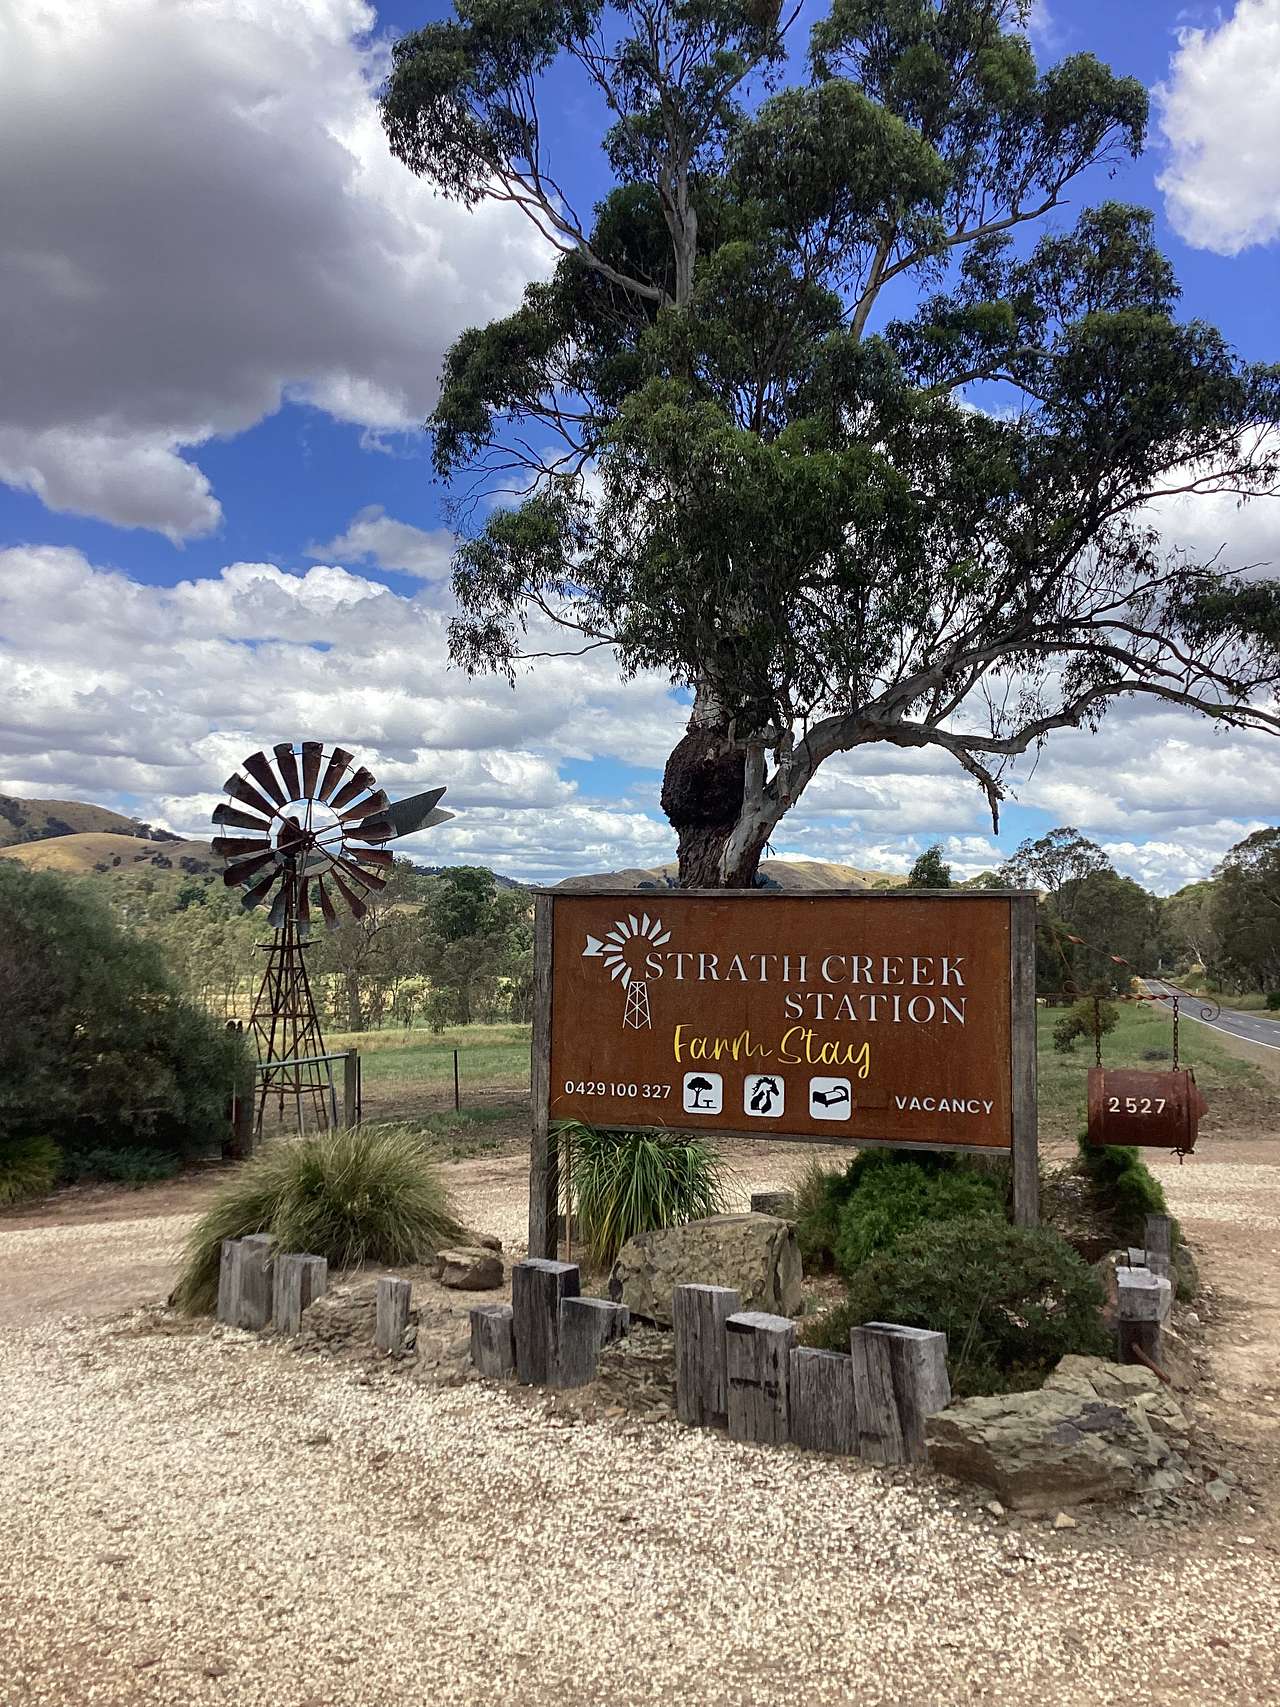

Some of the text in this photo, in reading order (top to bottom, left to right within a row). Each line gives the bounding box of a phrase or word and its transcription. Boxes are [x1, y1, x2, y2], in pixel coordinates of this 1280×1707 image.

[645, 951, 966, 987] STRATH CREEK
[784, 992, 967, 1025] STATION
[673, 1024, 871, 1080] Farm Stay
[564, 1080, 672, 1100] 0429 100 327
[895, 1095, 994, 1115] VACANCY
[1108, 1097, 1166, 1114] 2527
